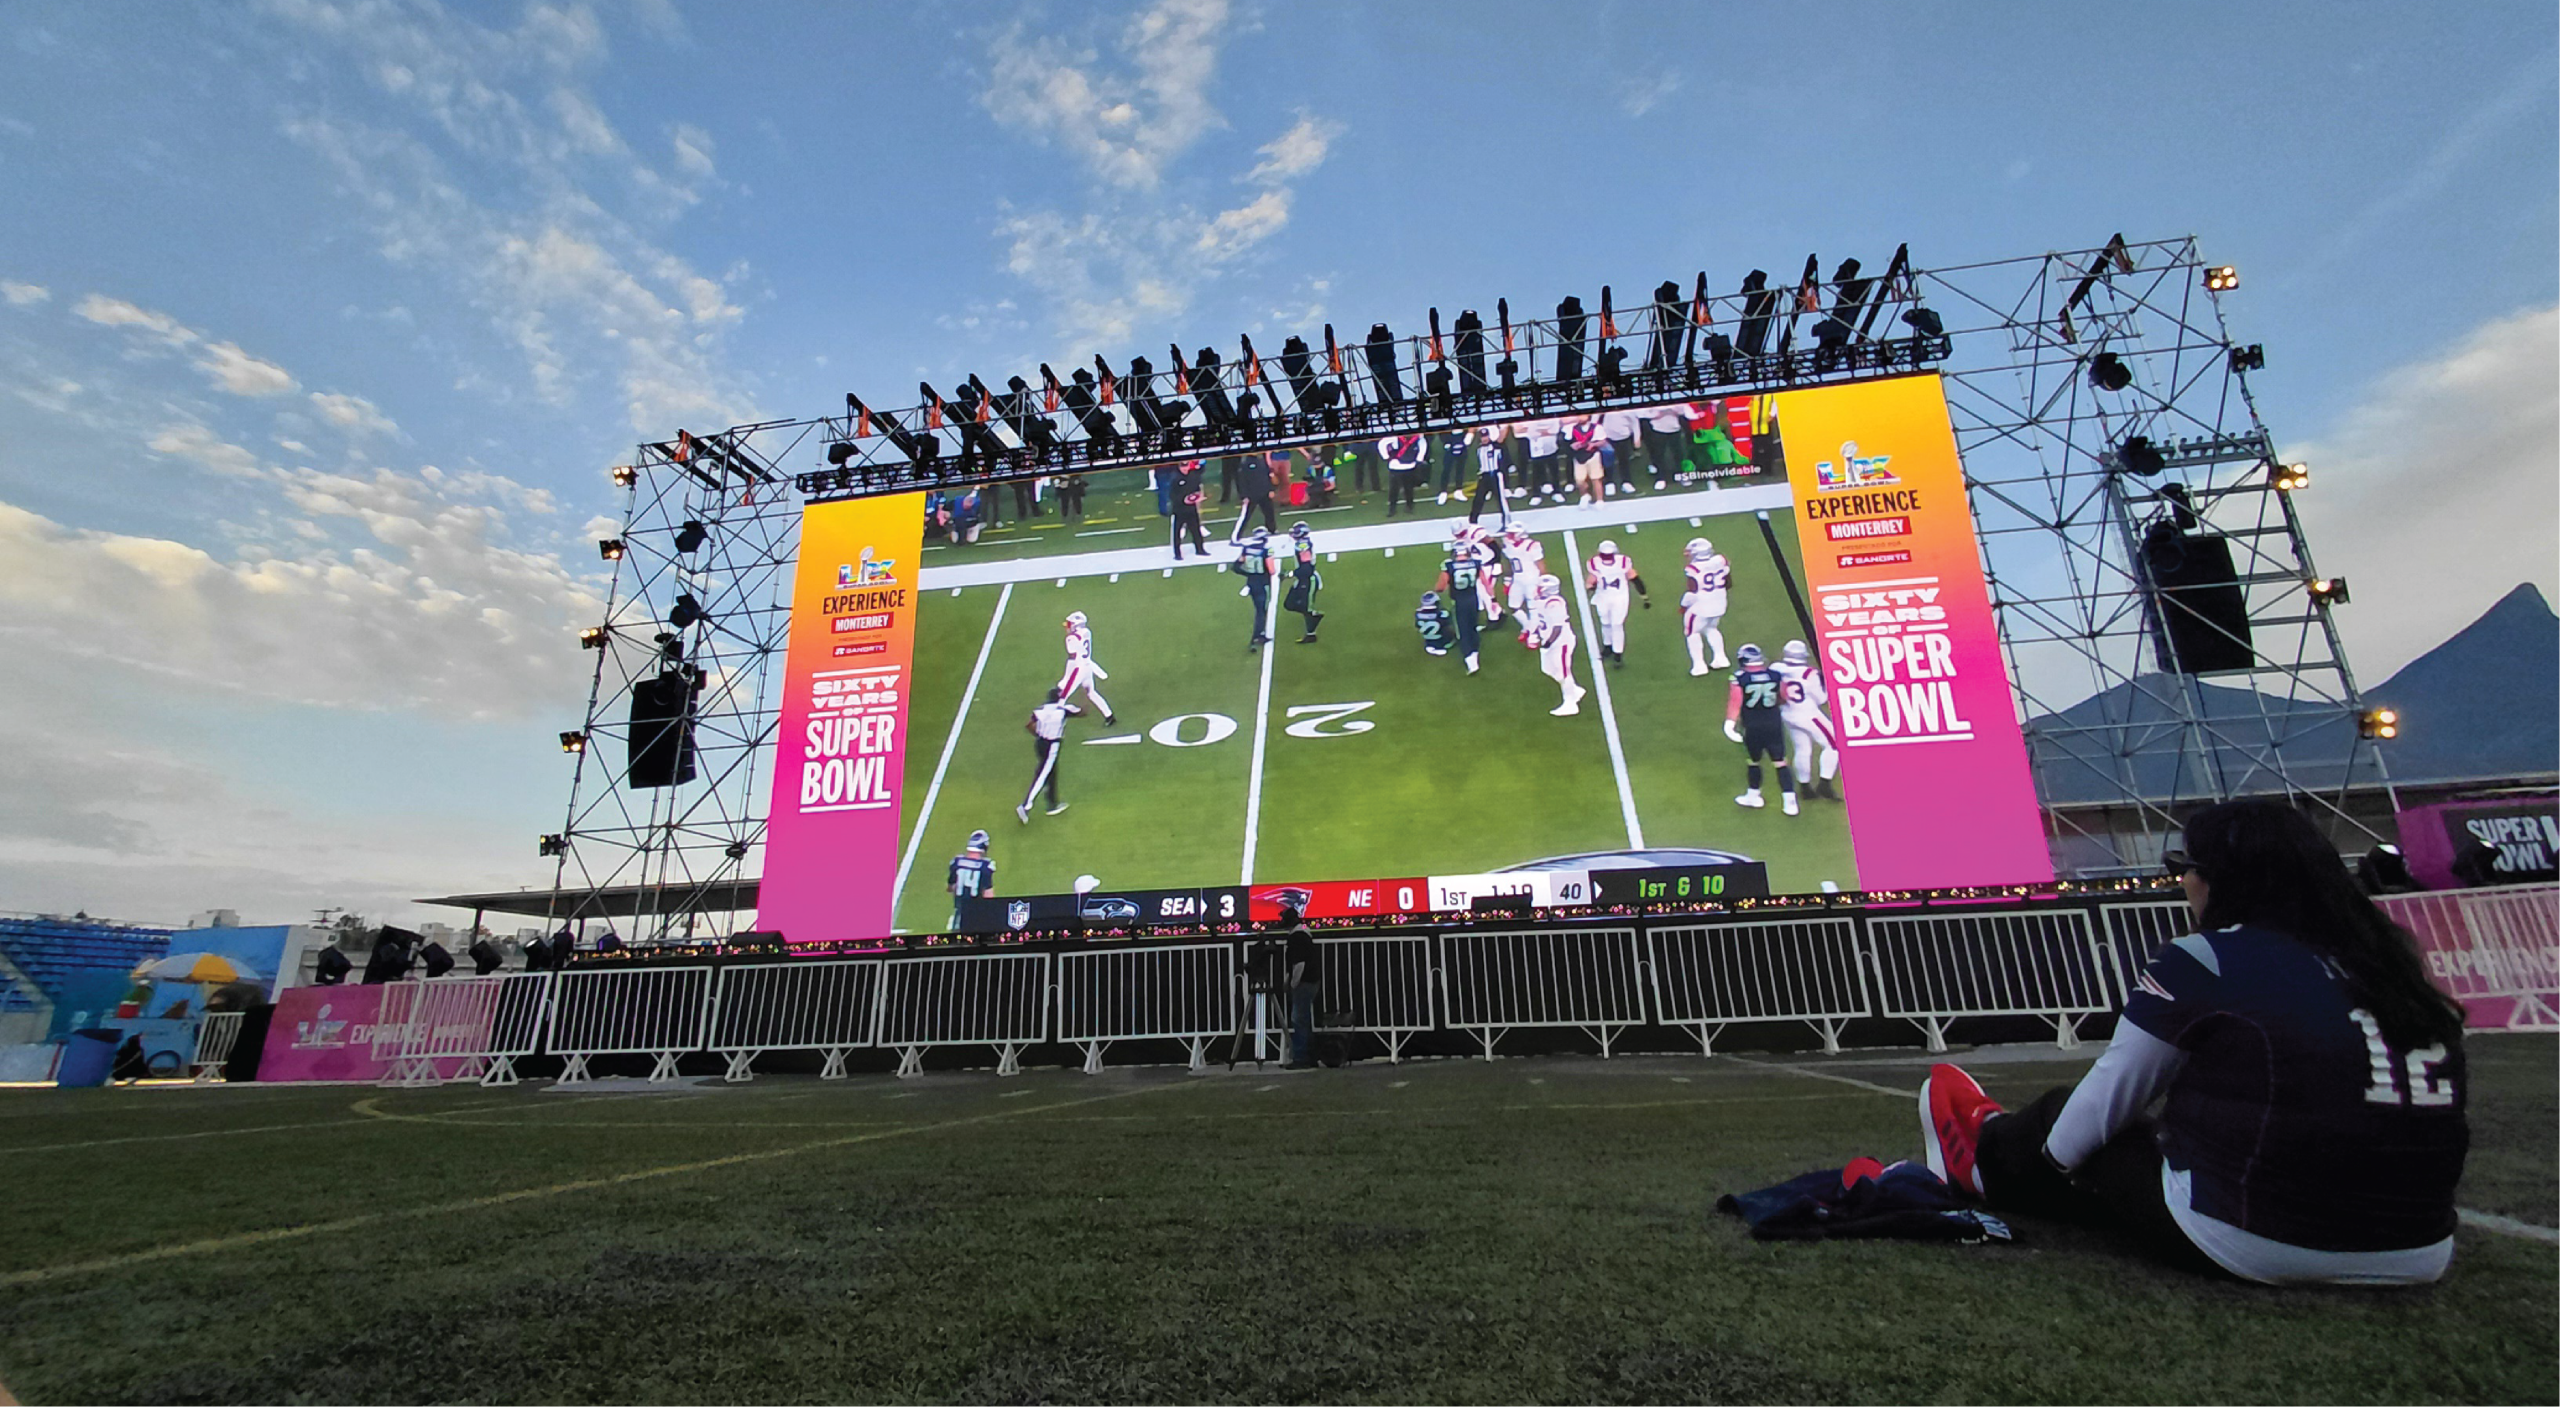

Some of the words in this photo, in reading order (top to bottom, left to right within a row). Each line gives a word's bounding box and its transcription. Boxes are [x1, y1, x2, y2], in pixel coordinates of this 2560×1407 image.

[1674, 465, 1761, 481] #SBInolvidable
[1806, 490, 1921, 519] EXPERIENCE
[1831, 519, 1904, 538] MONTERREY
[823, 589, 906, 615] EXPERIENCE
[1822, 588, 1940, 611] SIXTY
[835, 614, 889, 631] MONTERREY
[1824, 606, 1946, 627] YEARS
[1872, 625, 1901, 635] OF
[1828, 633, 1957, 684] SUPER
[812, 675, 900, 695] SIXTY
[811, 690, 898, 709] YEARS
[1837, 681, 1971, 737] BOWL
[804, 714, 895, 759] SUPER
[800, 756, 891, 805] BOWL
[2466, 815, 2543, 844] SUPER
[2492, 842, 2555, 873] OWL
[1348, 889, 1373, 908] NE
[1398, 887, 1414, 909] 0
[1441, 887, 1467, 906] 1ST
[1559, 882, 1582, 900] 40
[1639, 878, 1667, 898] 1ST
[1702, 875, 1725, 896] 10
[1159, 897, 1195, 916] SEA
[1220, 895, 1236, 918] 3
[2349, 1008, 2453, 1106] 12
